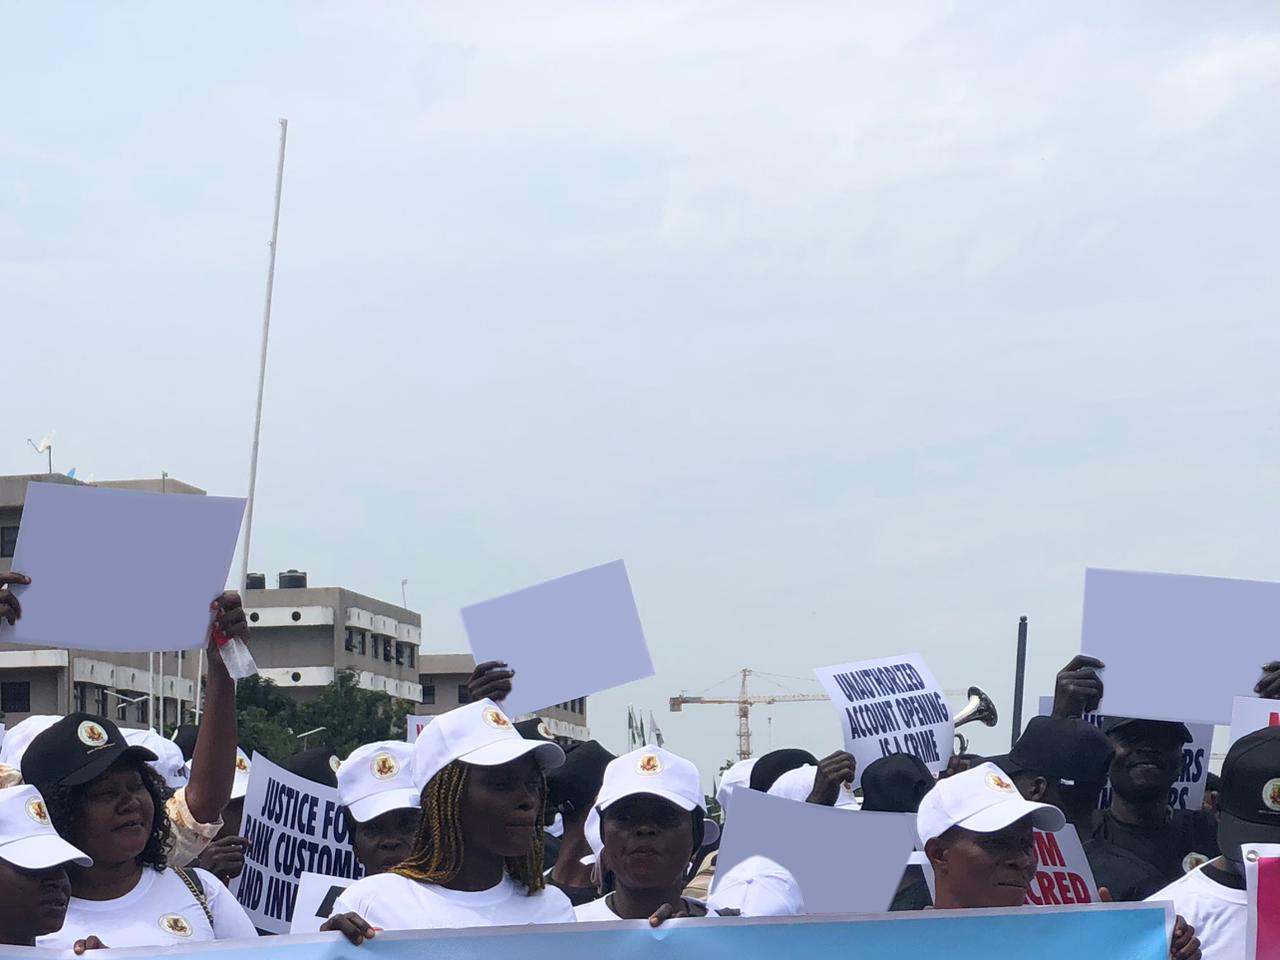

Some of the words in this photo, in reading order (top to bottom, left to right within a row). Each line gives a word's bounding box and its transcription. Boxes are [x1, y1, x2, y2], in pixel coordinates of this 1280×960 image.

[833, 663, 926, 703] UNAUTHORIZED
[845, 700, 901, 740] ACCOUNT
[896, 691, 950, 729] OPENING
[904, 729, 941, 764] CRIME
[261, 777, 320, 837] JUSTICE
[236, 863, 264, 911] AND
